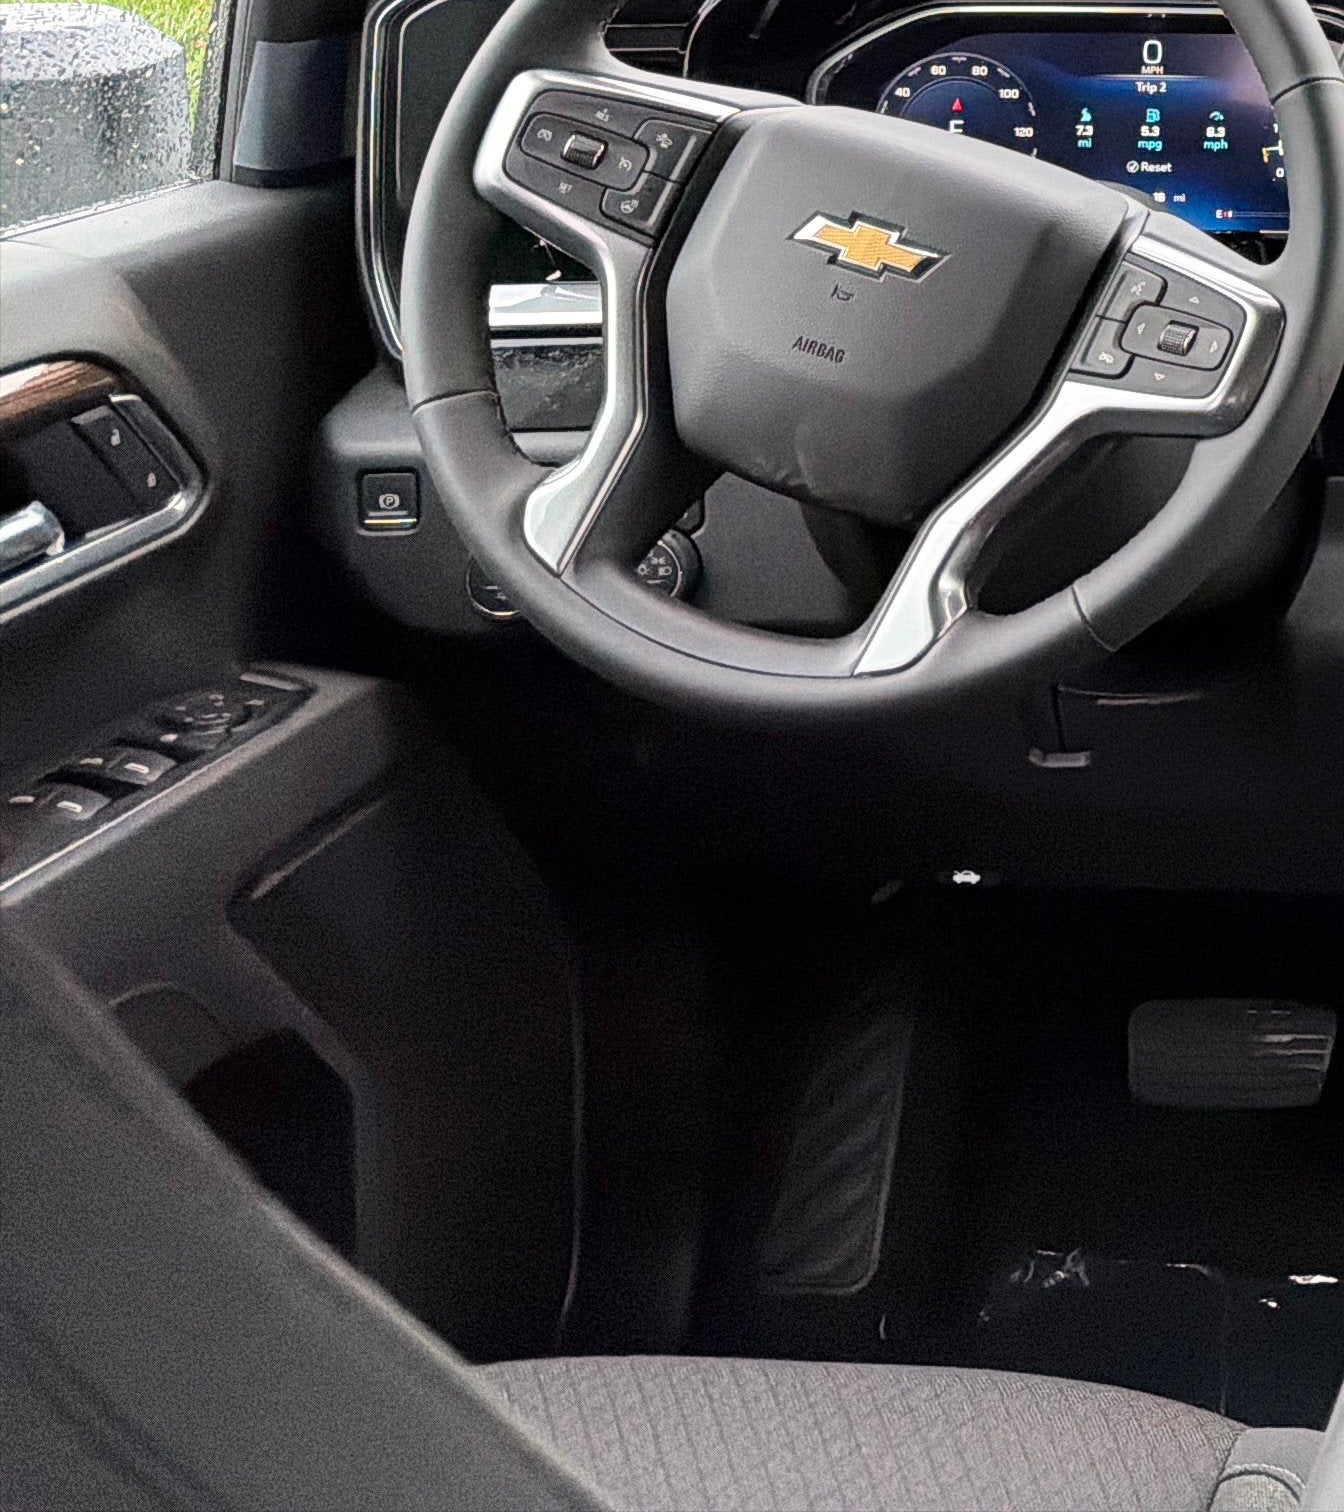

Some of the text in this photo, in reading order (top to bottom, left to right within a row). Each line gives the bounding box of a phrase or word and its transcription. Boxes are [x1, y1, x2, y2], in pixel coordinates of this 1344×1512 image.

[1142, 39, 1163, 65] 0
[930, 65, 947, 76] 60
[971, 65, 988, 76] 80
[1141, 65, 1164, 75] MPH
[895, 87, 910, 99] 40
[999, 87, 1020, 100] 100
[1135, 81, 1167, 95] Trip 2
[1014, 126, 1034, 138] 120
[1075, 125, 1094, 136] 7.3
[1140, 125, 1160, 137] 5.3
[1077, 137, 1092, 148] mi
[1137, 139, 1163, 152] mpg
[1203, 139, 1229, 152] mph
[1140, 161, 1173, 173] Reset
[1275, 167, 1284, 178] 0
[1173, 193, 1186, 203] mi
[791, 335, 846, 364] AIRBAG
